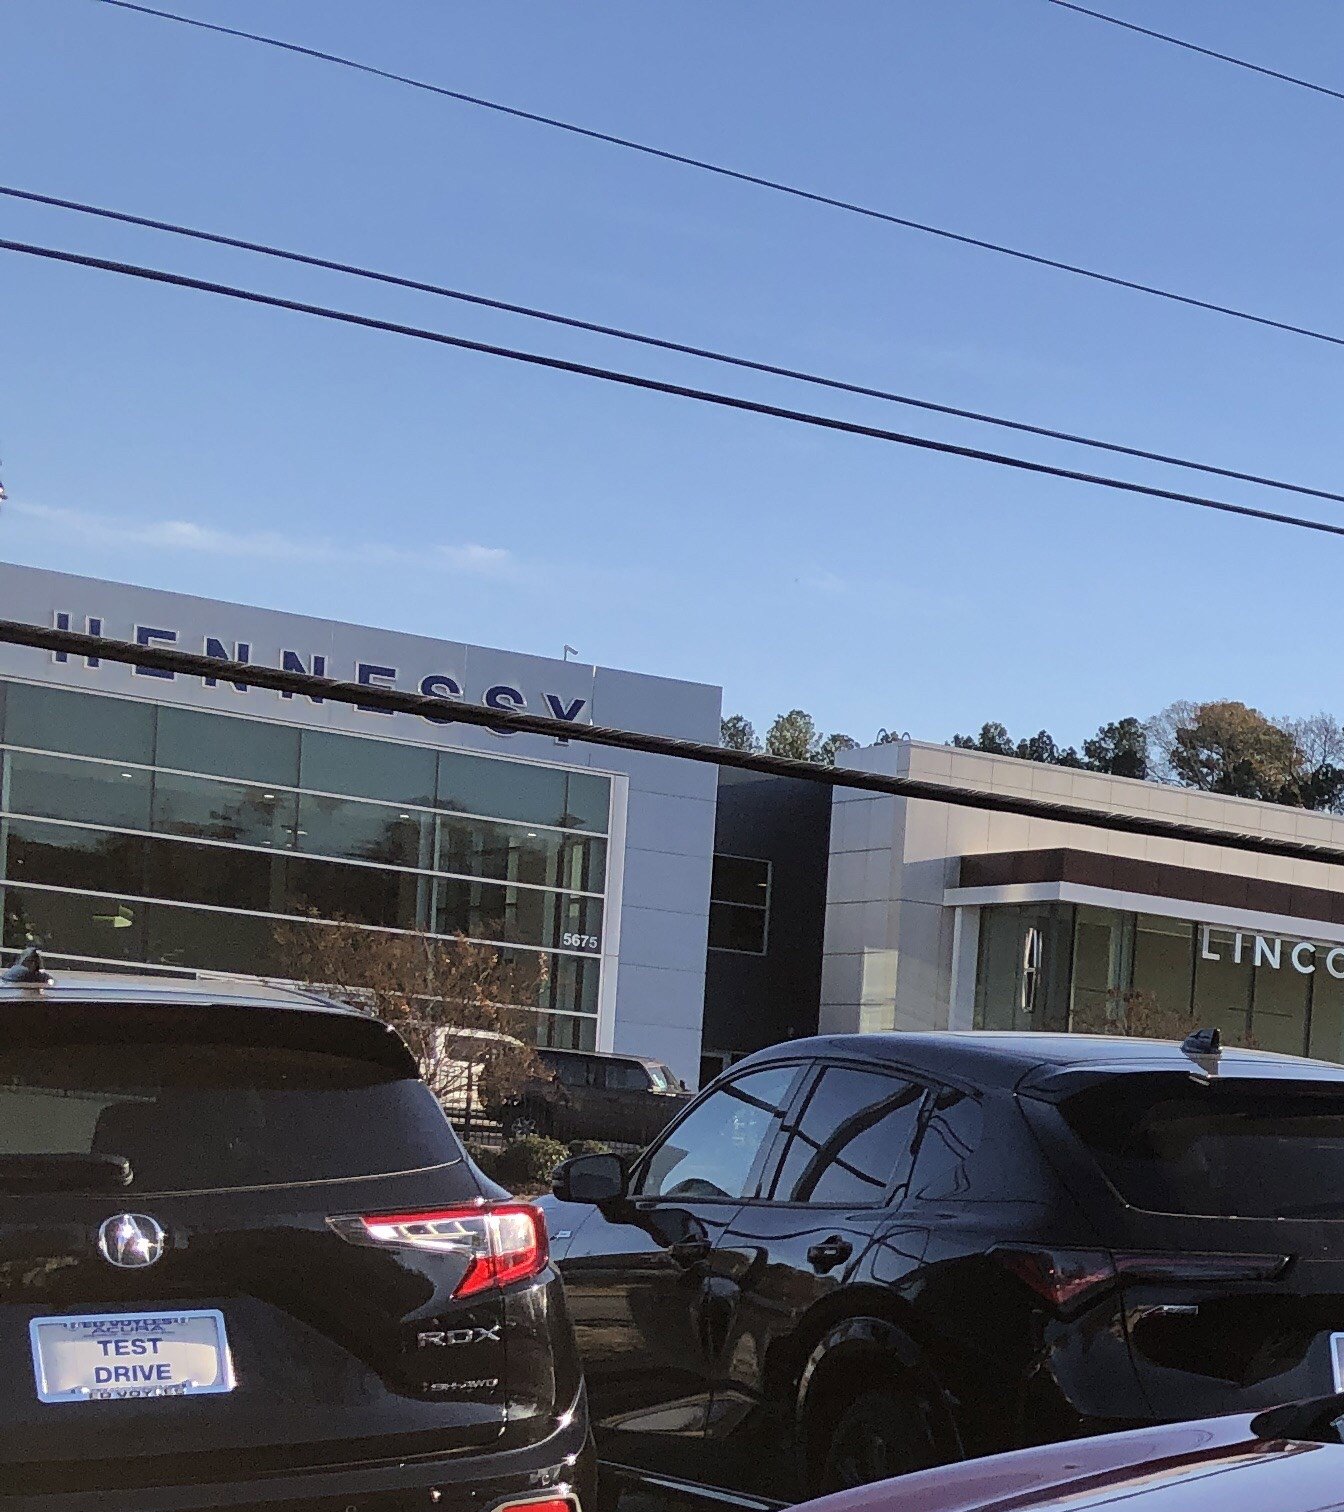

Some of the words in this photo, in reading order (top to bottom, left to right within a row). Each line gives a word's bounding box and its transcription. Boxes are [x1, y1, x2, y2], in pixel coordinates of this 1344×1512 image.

[52, 609, 588, 747] HENNESSY
[563, 932, 598, 949] 5675
[417, 1323, 501, 1348] RDX
[97, 1337, 163, 1356] TEST
[94, 1363, 172, 1383] DRIVE
